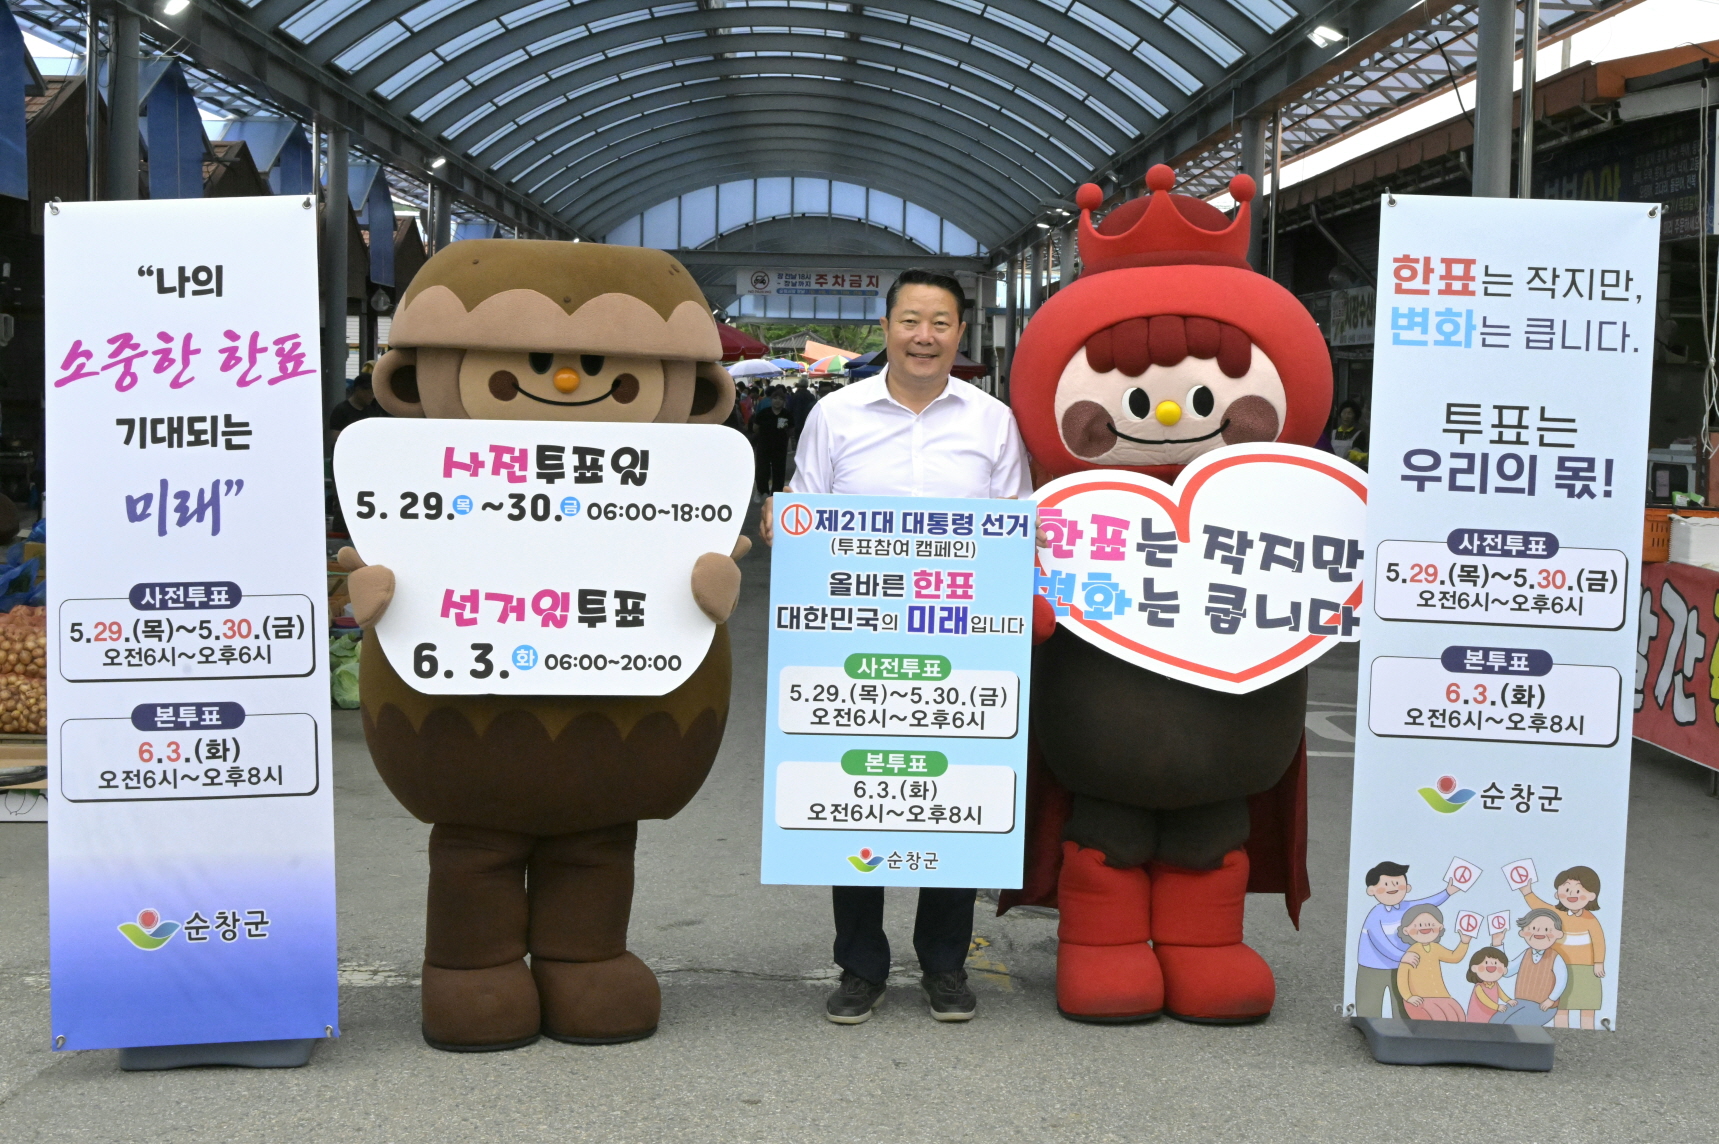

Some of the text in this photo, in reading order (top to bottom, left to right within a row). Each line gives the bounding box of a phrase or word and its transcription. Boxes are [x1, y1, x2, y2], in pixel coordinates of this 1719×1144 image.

[814, 273, 880, 289] 주차금지
[1393, 254, 1641, 304] 한표는 작지만,
[1390, 307, 1639, 353] 변화는 큽니다.
[54, 330, 316, 392] 소중한 한표
[116, 414, 252, 450] 기대되는
[1442, 403, 1577, 448] 투표는
[443, 445, 649, 486] 사전투표일
[1401, 449, 1613, 499] 우리의 몫!
[587, 503, 732, 522] 06:00~18:00
[815, 510, 1028, 537] 제21대 대통령 선거
[832, 538, 975, 558] (투표참여 캠페인)
[1038, 508, 1365, 583] 한표는 작지만
[1458, 532, 1549, 556] 사전투표
[830, 570, 973, 599] 올바른 한표
[1386, 563, 1617, 594] 5.29.(목)~5.30.(금)
[141, 587, 232, 609] 사전투표
[440, 589, 647, 628] 선거일투표
[1204, 582, 1361, 636] 큽니다
[1417, 589, 1584, 616] 오전6시~오후6시
[70, 615, 304, 645] 5.29.(목)~5.30.(금)
[777, 606, 1024, 634] 대한민국의 미래입니다
[103, 644, 271, 667] 오전6시~오후6시
[545, 654, 681, 671] 06:00~20:00
[858, 658, 941, 678] 사전투표
[1464, 648, 1531, 671] 본투표
[790, 683, 1007, 709] 5.29.(목)~5.30.(금)
[1445, 682, 1546, 710] 6.3.(화)
[155, 707, 224, 730] 본투표
[810, 706, 984, 730] 오전6시~오후6시
[1404, 707, 1585, 736] 오전6시~오후8시
[139, 737, 240, 764] 6.3.(화)
[865, 753, 927, 773] 본투표
[98, 763, 282, 789] 오전6시~오후8시
[854, 780, 937, 801] 6.3.(화)
[1481, 782, 1562, 813] 순창군
[808, 803, 981, 825] 오전6시~오후8시
[887, 851, 938, 870] 순창군
[185, 911, 269, 941] 순창군
